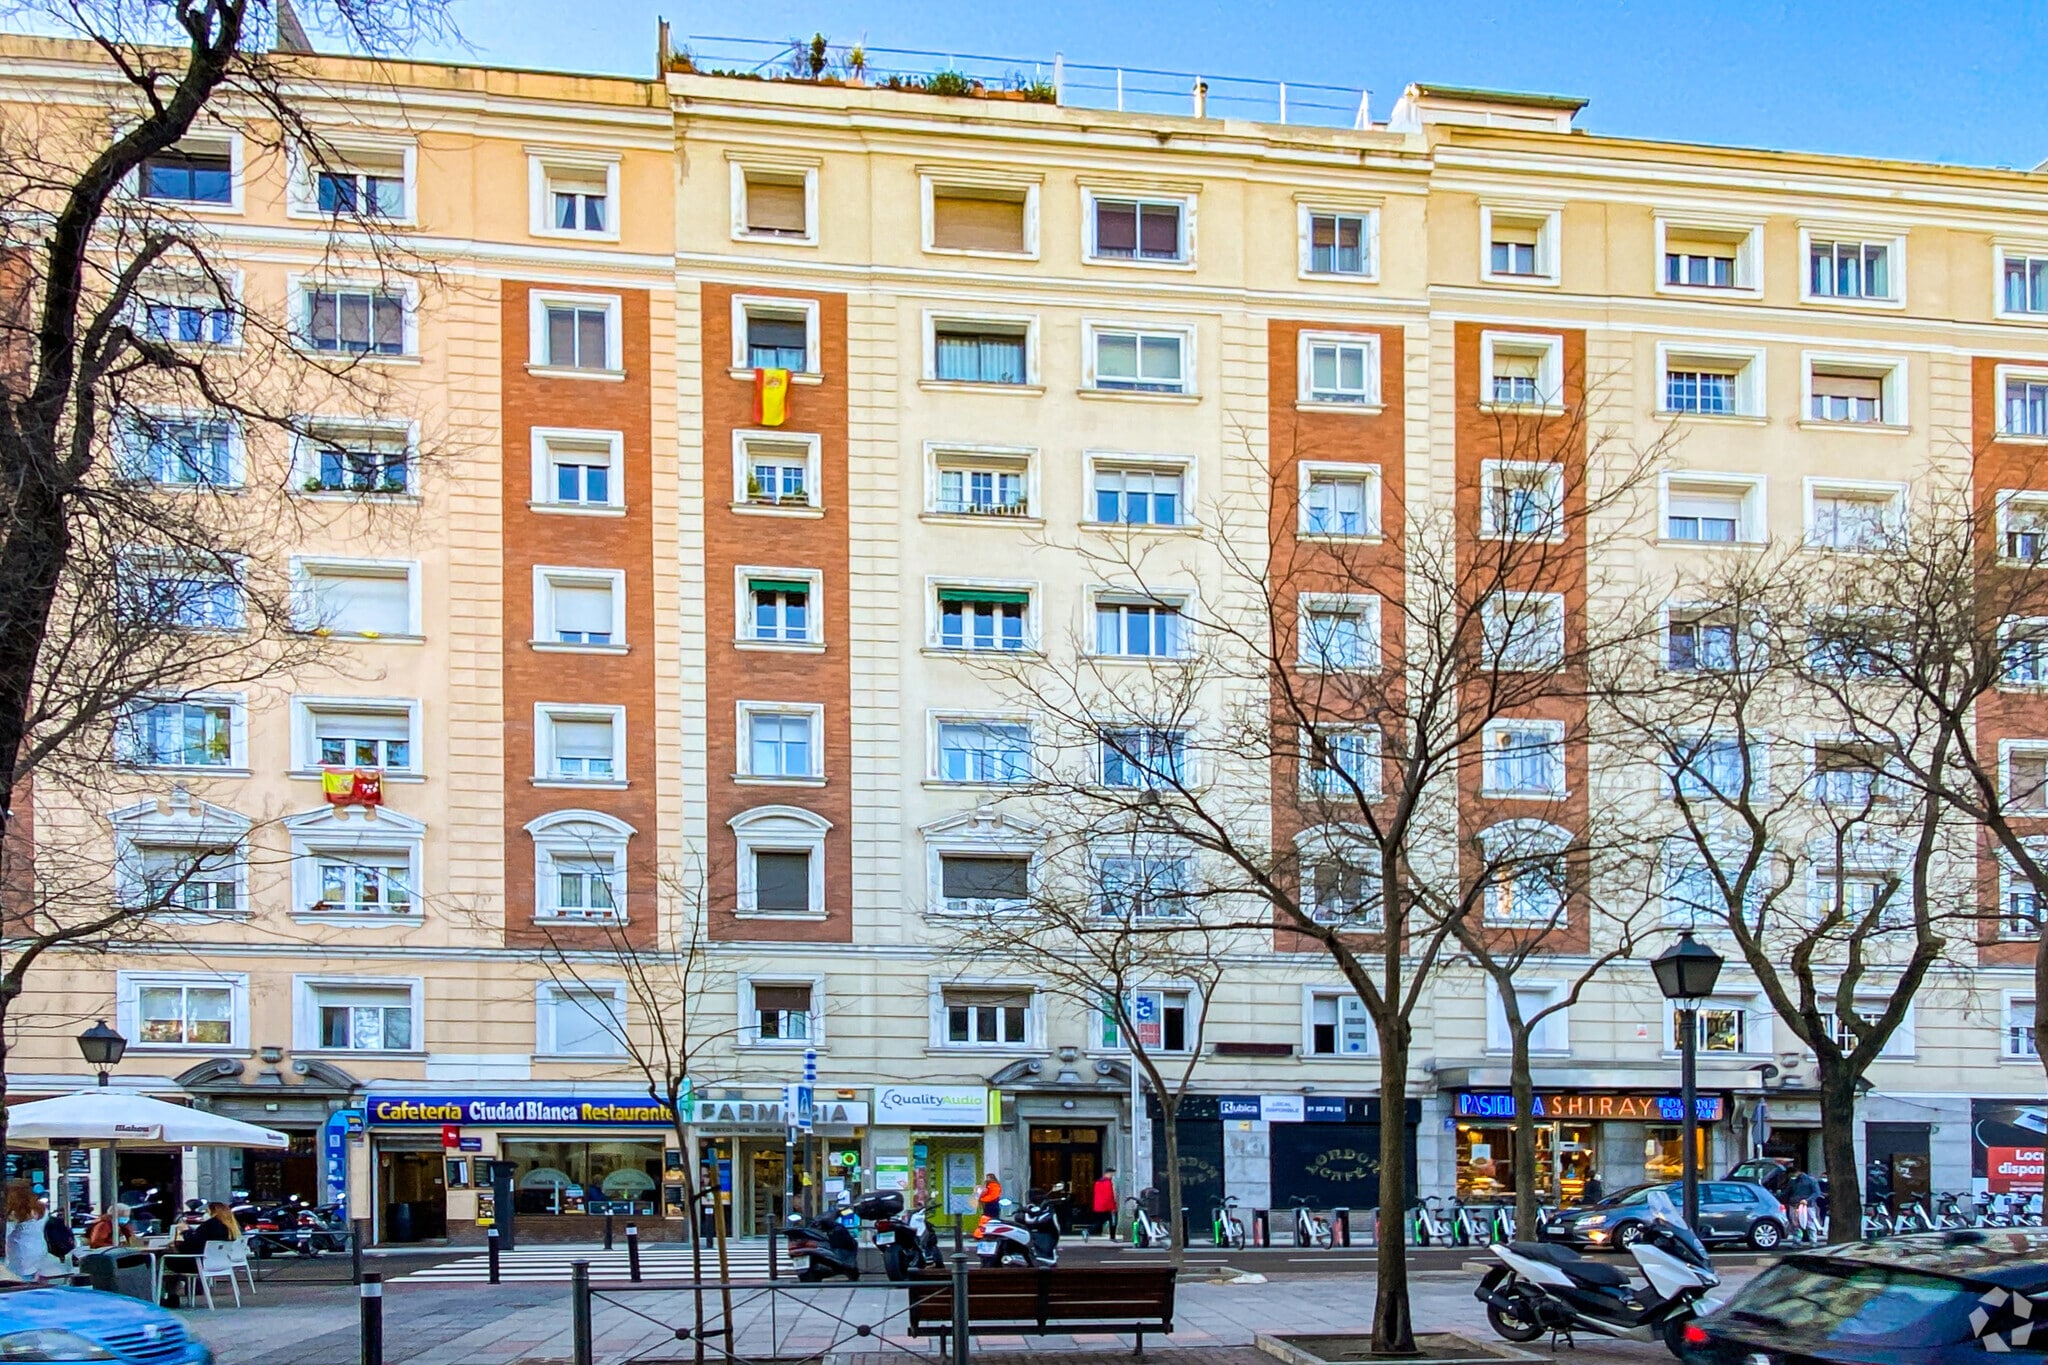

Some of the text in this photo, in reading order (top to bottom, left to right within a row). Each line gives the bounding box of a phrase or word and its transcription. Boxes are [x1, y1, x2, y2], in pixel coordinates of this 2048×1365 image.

[468, 1100, 525, 1121] Ciudad
[525, 1101, 578, 1121] Blanca
[581, 1102, 673, 1121] Restaurante
[1221, 1101, 1258, 1114] Rubica
[1552, 1096, 1652, 1117] SHIRAY
